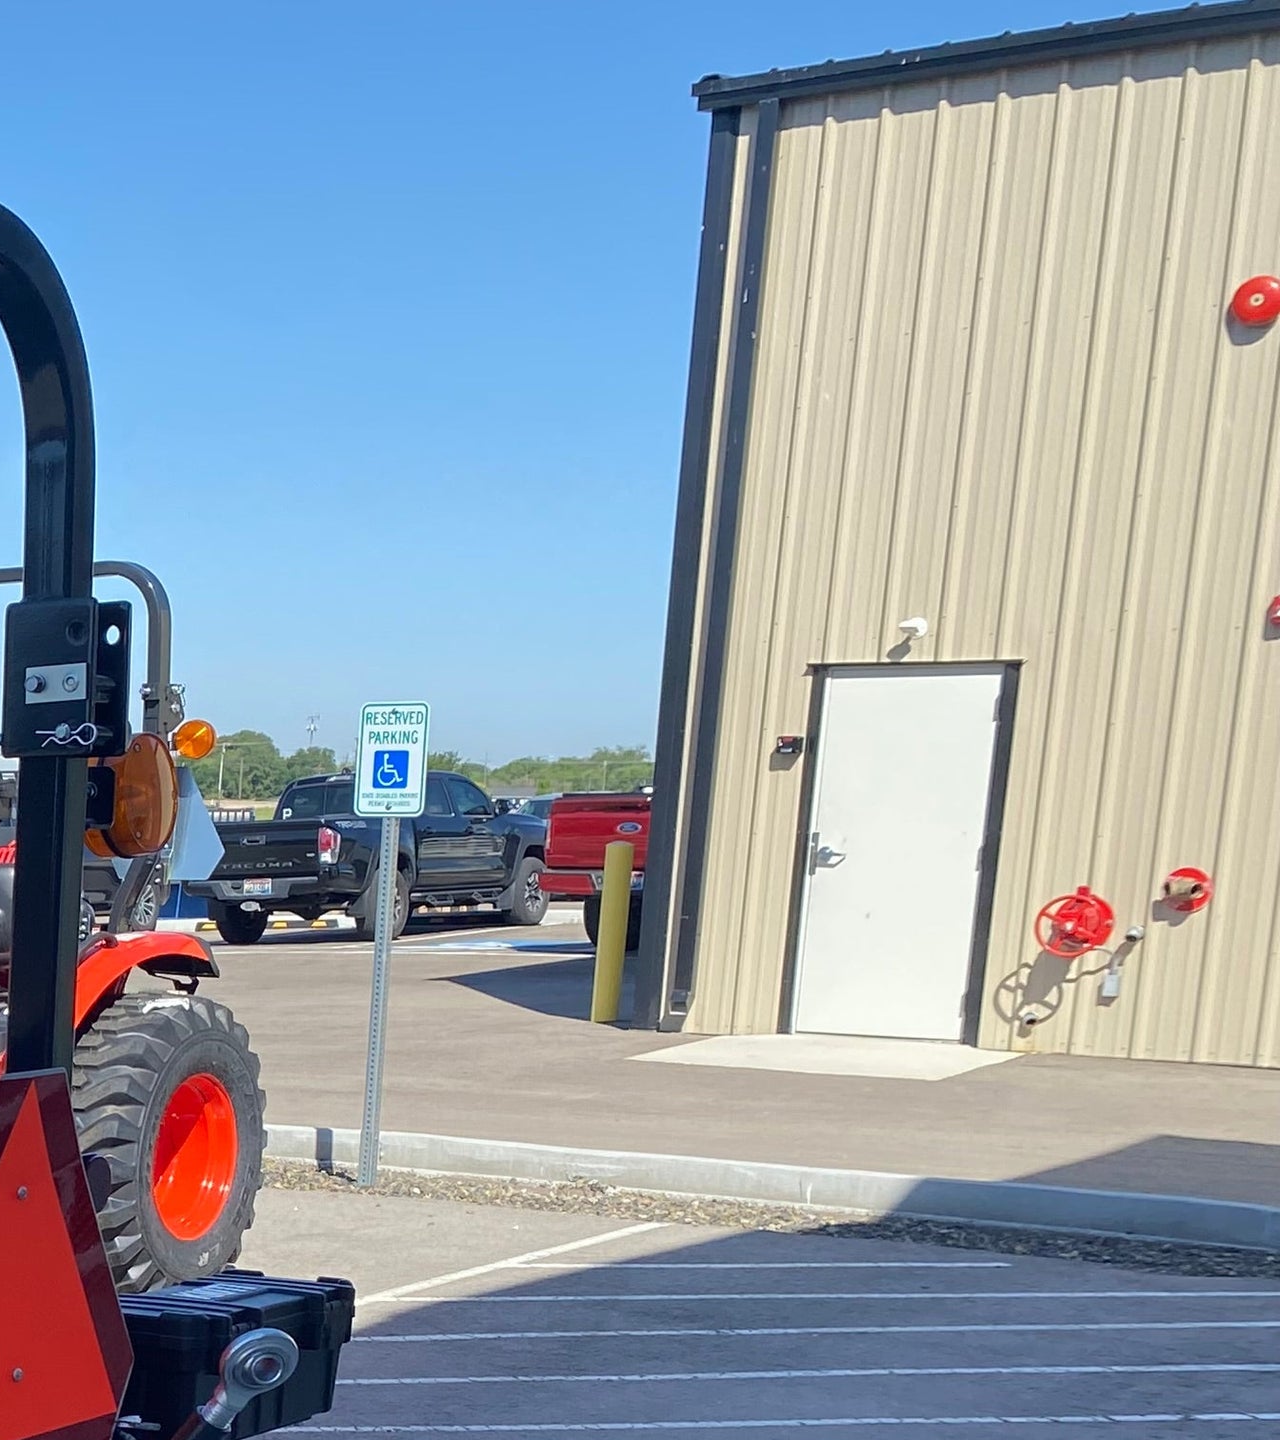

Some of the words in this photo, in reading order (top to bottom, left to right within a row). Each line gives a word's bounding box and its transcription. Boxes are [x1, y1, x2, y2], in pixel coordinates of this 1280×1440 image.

[365, 711, 424, 726] RESERVED
[368, 730, 419, 744] PARKING
[222, 861, 293, 870] TACOMA
